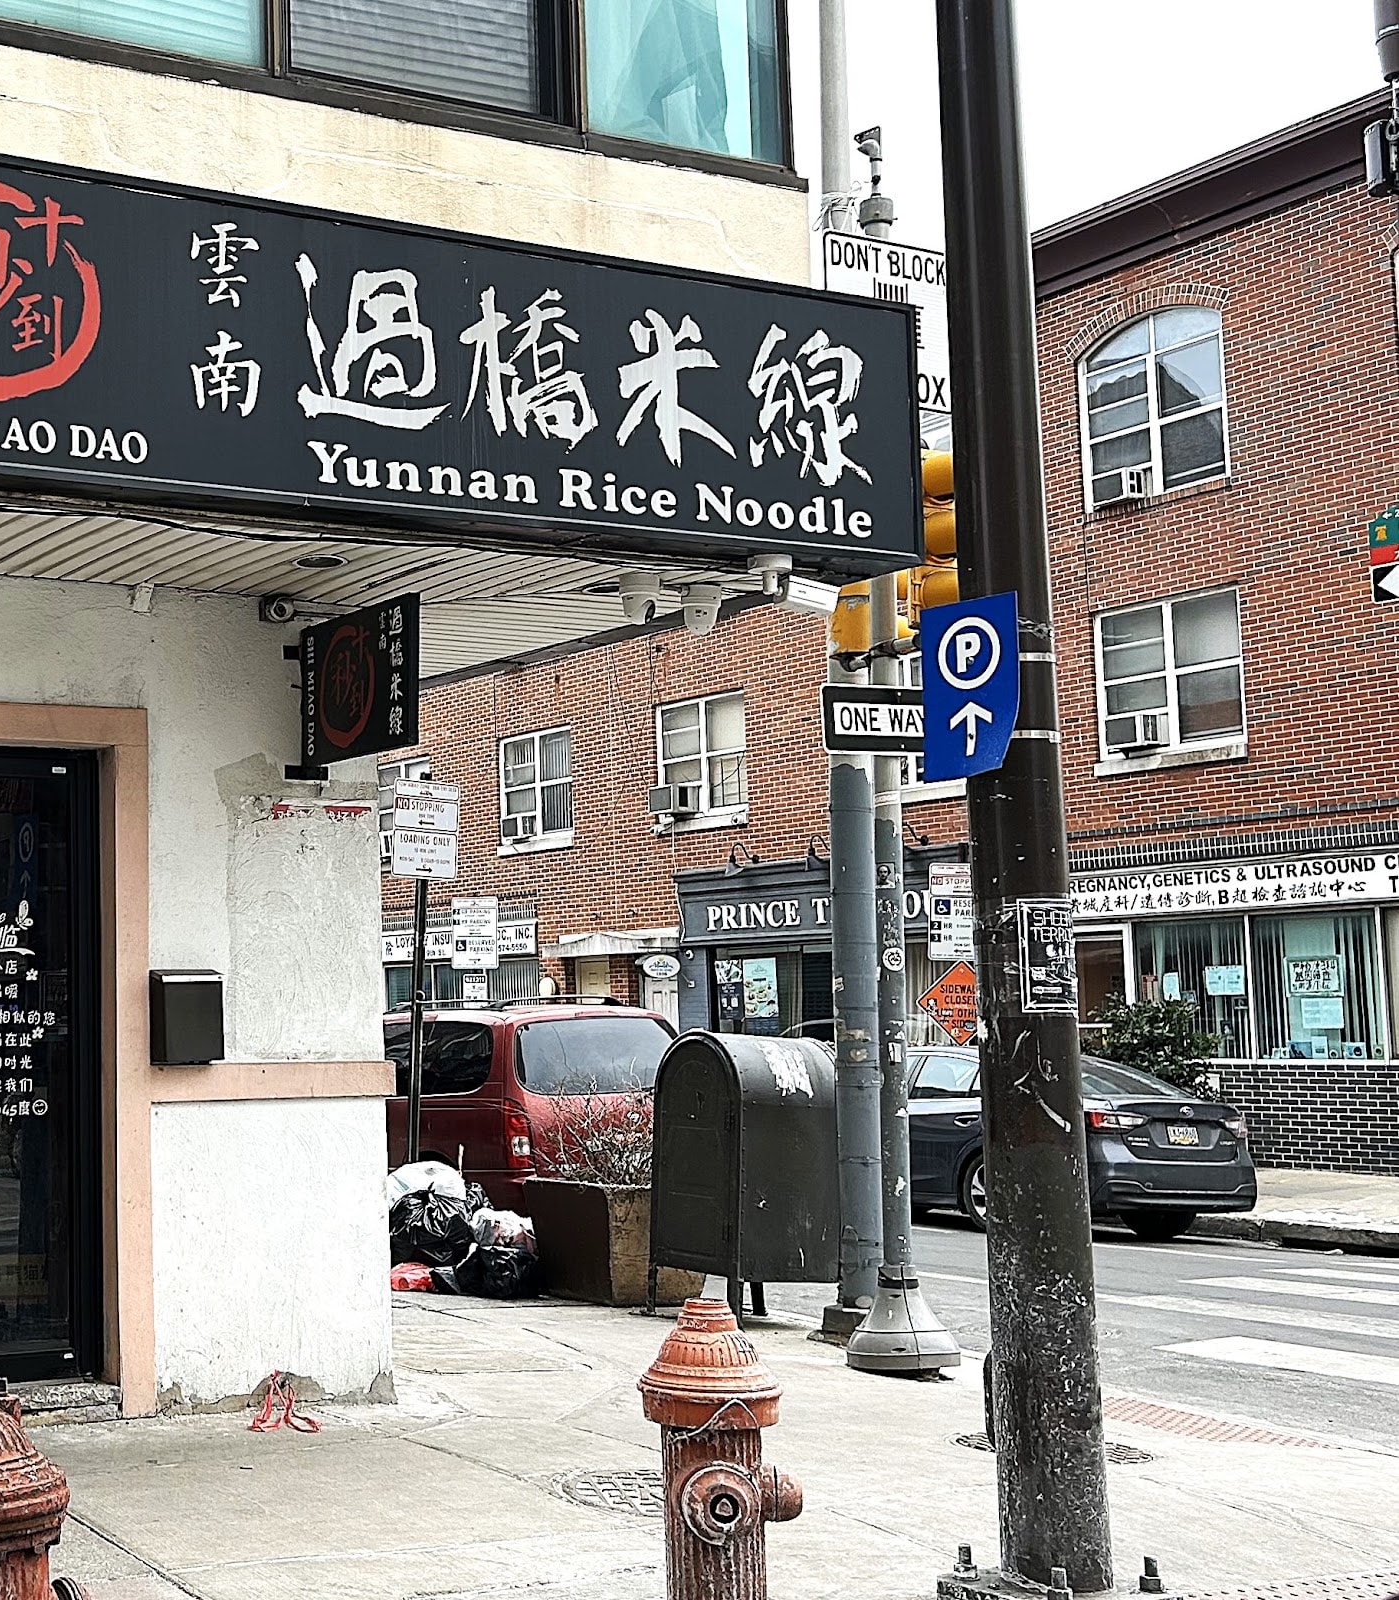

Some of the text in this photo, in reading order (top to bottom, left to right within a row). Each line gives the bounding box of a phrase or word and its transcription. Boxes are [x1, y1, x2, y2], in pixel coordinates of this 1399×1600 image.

[830, 238, 946, 288] DON'T BLOCK
[295, 252, 874, 488] 過橋米線
[69, 424, 148, 464] DAO
[306, 440, 874, 539] Yunnan Rice Noodle
[955, 632, 981, 674] P
[307, 636, 315, 757] SHI MIAO DAO
[839, 706, 881, 732] ONE
[412, 801, 444, 813] STOPPING
[400, 834, 451, 847] LOADING ONLY
[1236, 871, 1247, 882] &
[1254, 856, 1376, 881] ULTRASOUND
[706, 899, 801, 931] PRINCE
[811, 897, 833, 926] T
